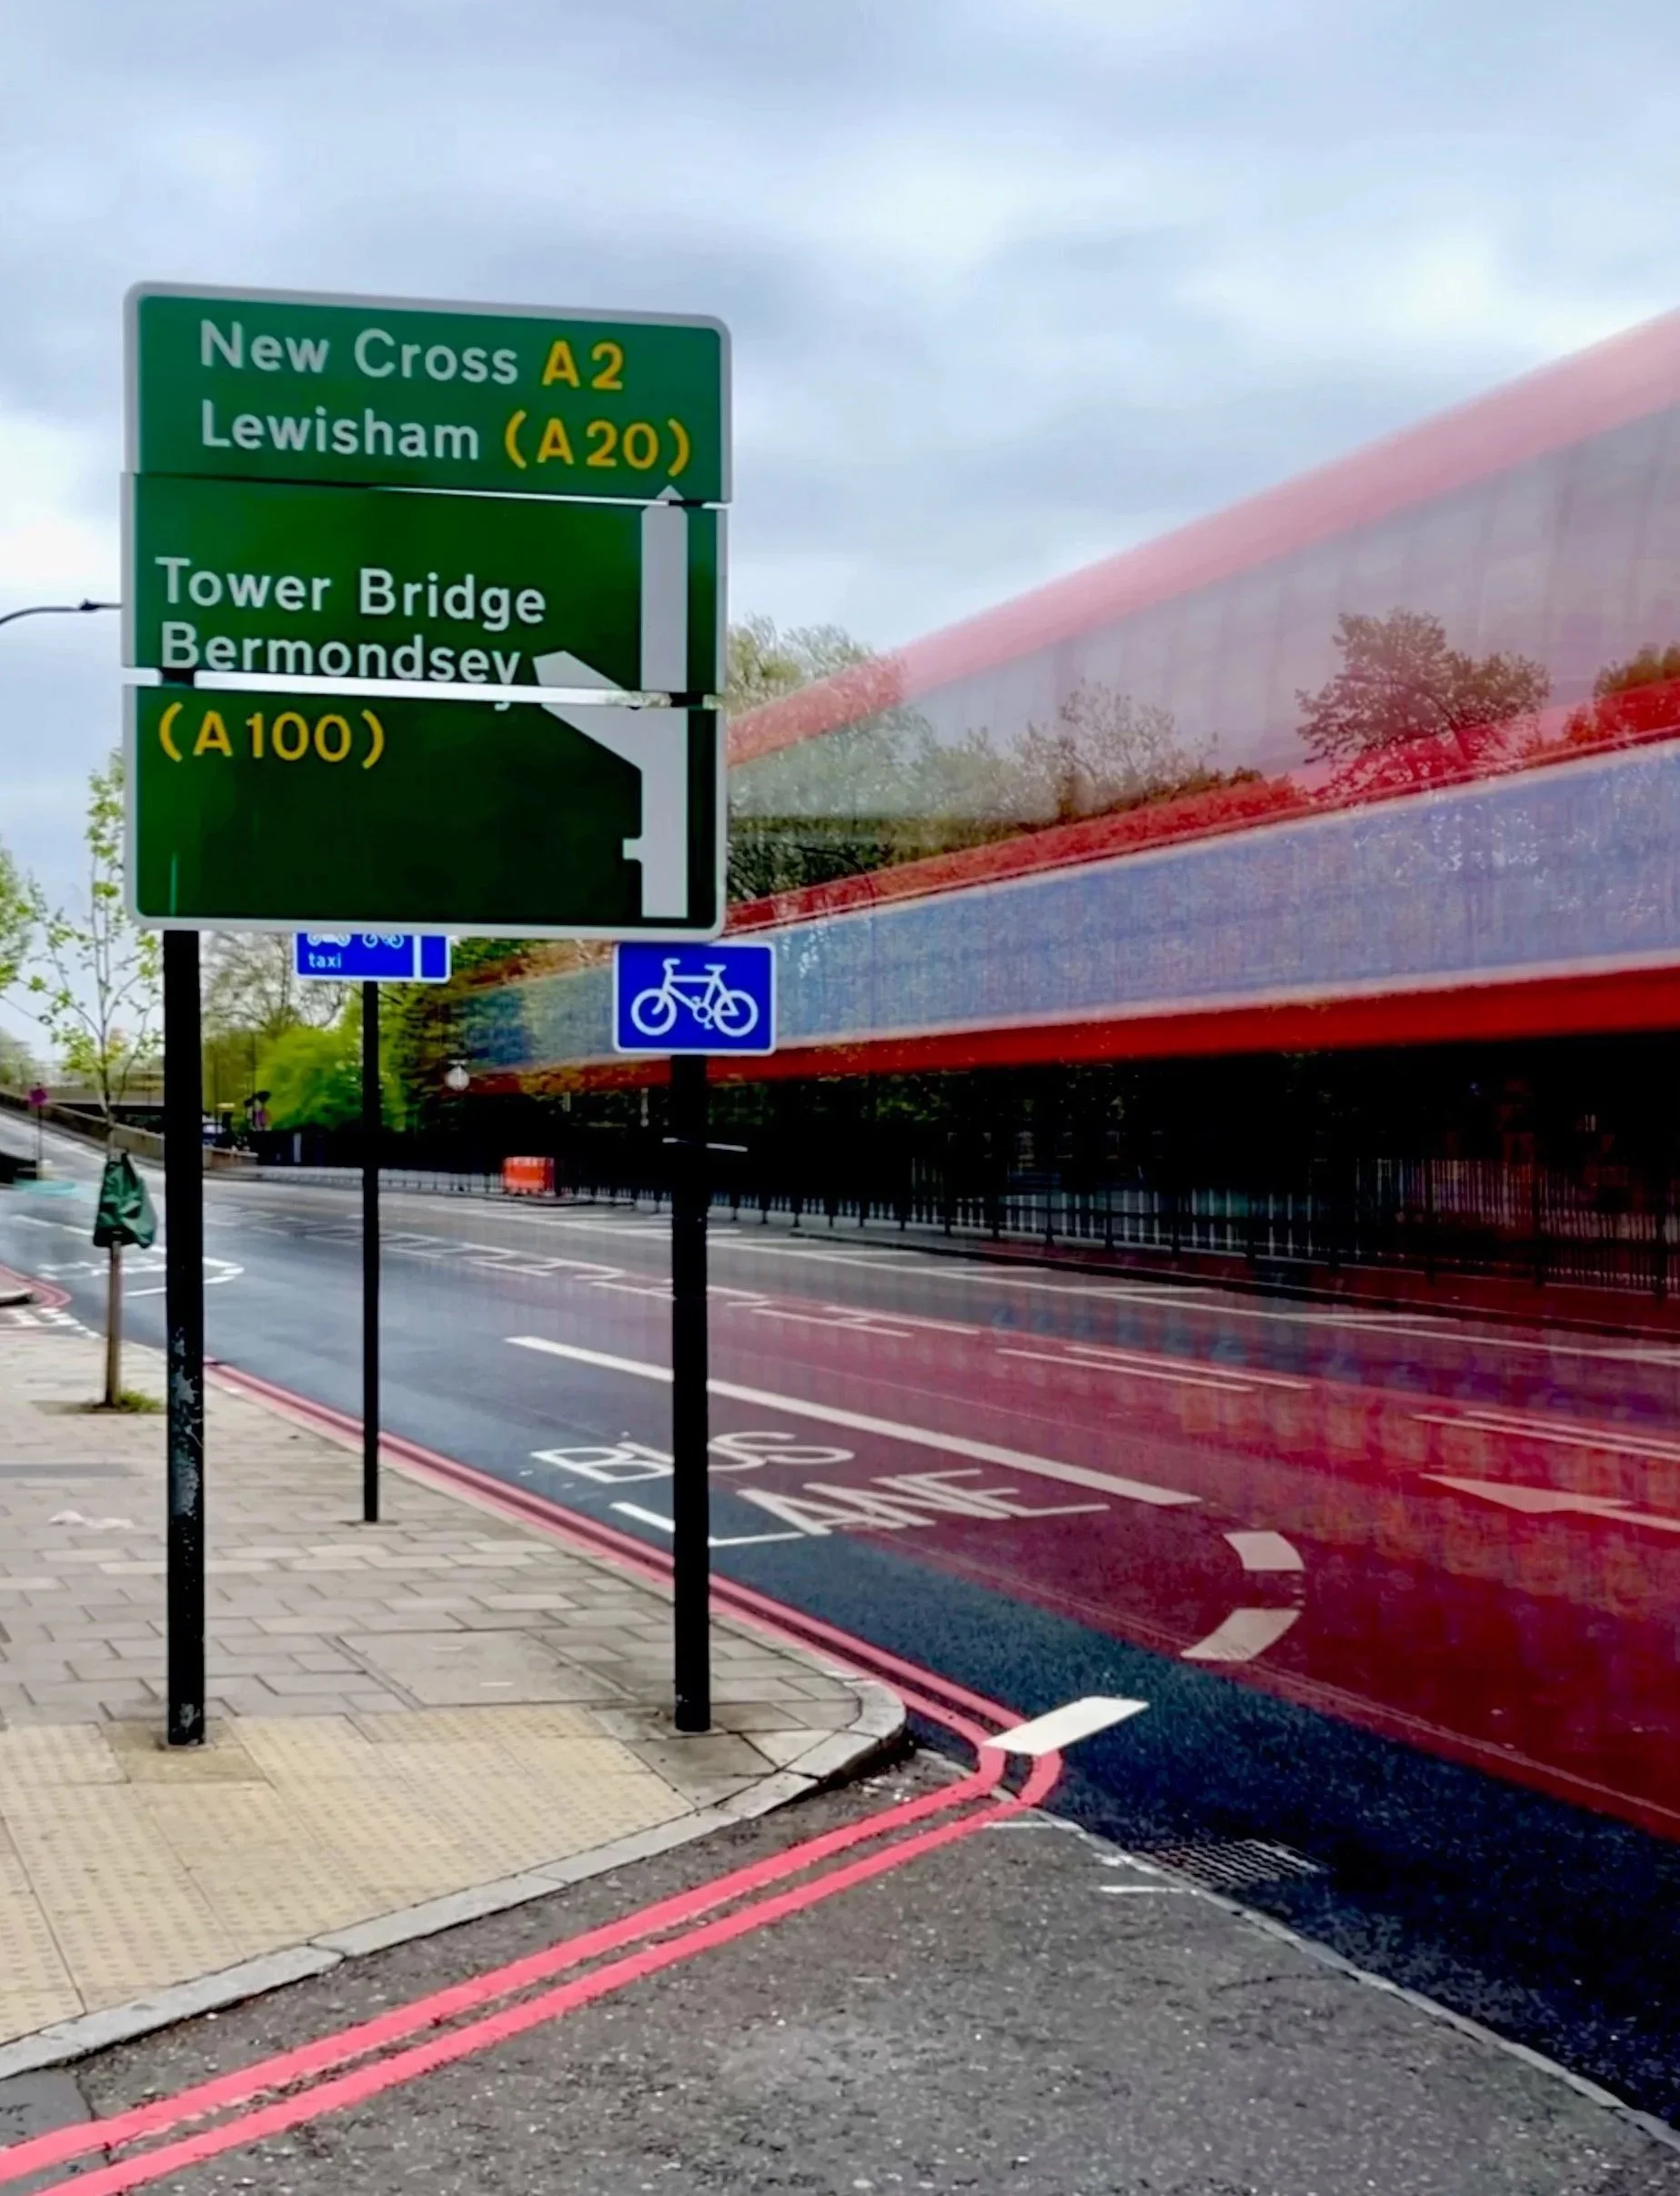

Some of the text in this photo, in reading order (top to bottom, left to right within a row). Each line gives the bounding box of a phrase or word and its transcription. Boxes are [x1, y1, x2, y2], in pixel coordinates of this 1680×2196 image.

[200, 319, 624, 390] New Cross A2
[202, 399, 690, 477] Lewisham (A20)
[155, 556, 547, 631] Tower Bridge
[161, 620, 521, 711] Bermondsey
[159, 702, 384, 769] (A100)
[308, 952, 342, 969] taxi
[609, 1468, 1110, 1547] LANE
